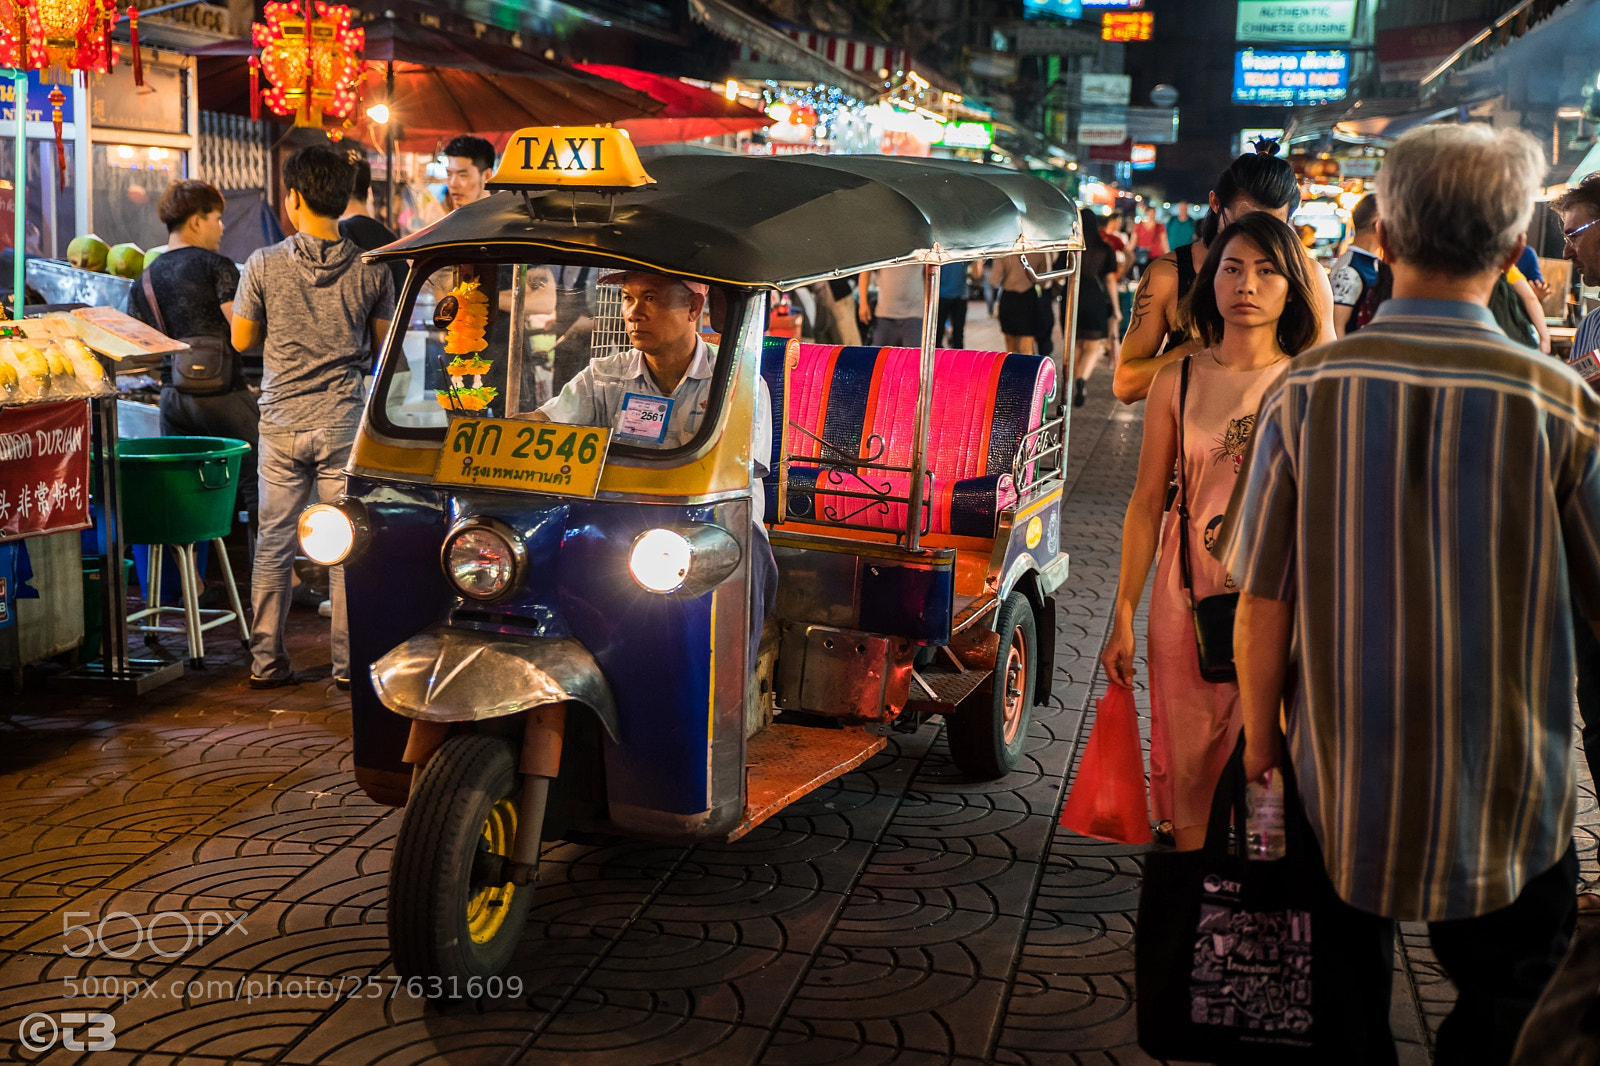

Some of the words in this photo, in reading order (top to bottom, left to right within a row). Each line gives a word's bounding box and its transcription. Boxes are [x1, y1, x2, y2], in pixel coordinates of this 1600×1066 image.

[1259, 6, 1331, 18] AUTHENTIC
[1242, 22, 1294, 33] CHINESE
[1298, 22, 1347, 34] CUISINE
[2, 108, 43, 122] NST
[516, 137, 605, 171] TAXI
[641, 411, 665, 422] 2561
[36, 426, 82, 457] DURIAN
[511, 427, 600, 465] 2546
[461, 463, 572, 486] กรุงเทพมหานคร
[1222, 880, 1242, 894] SET
